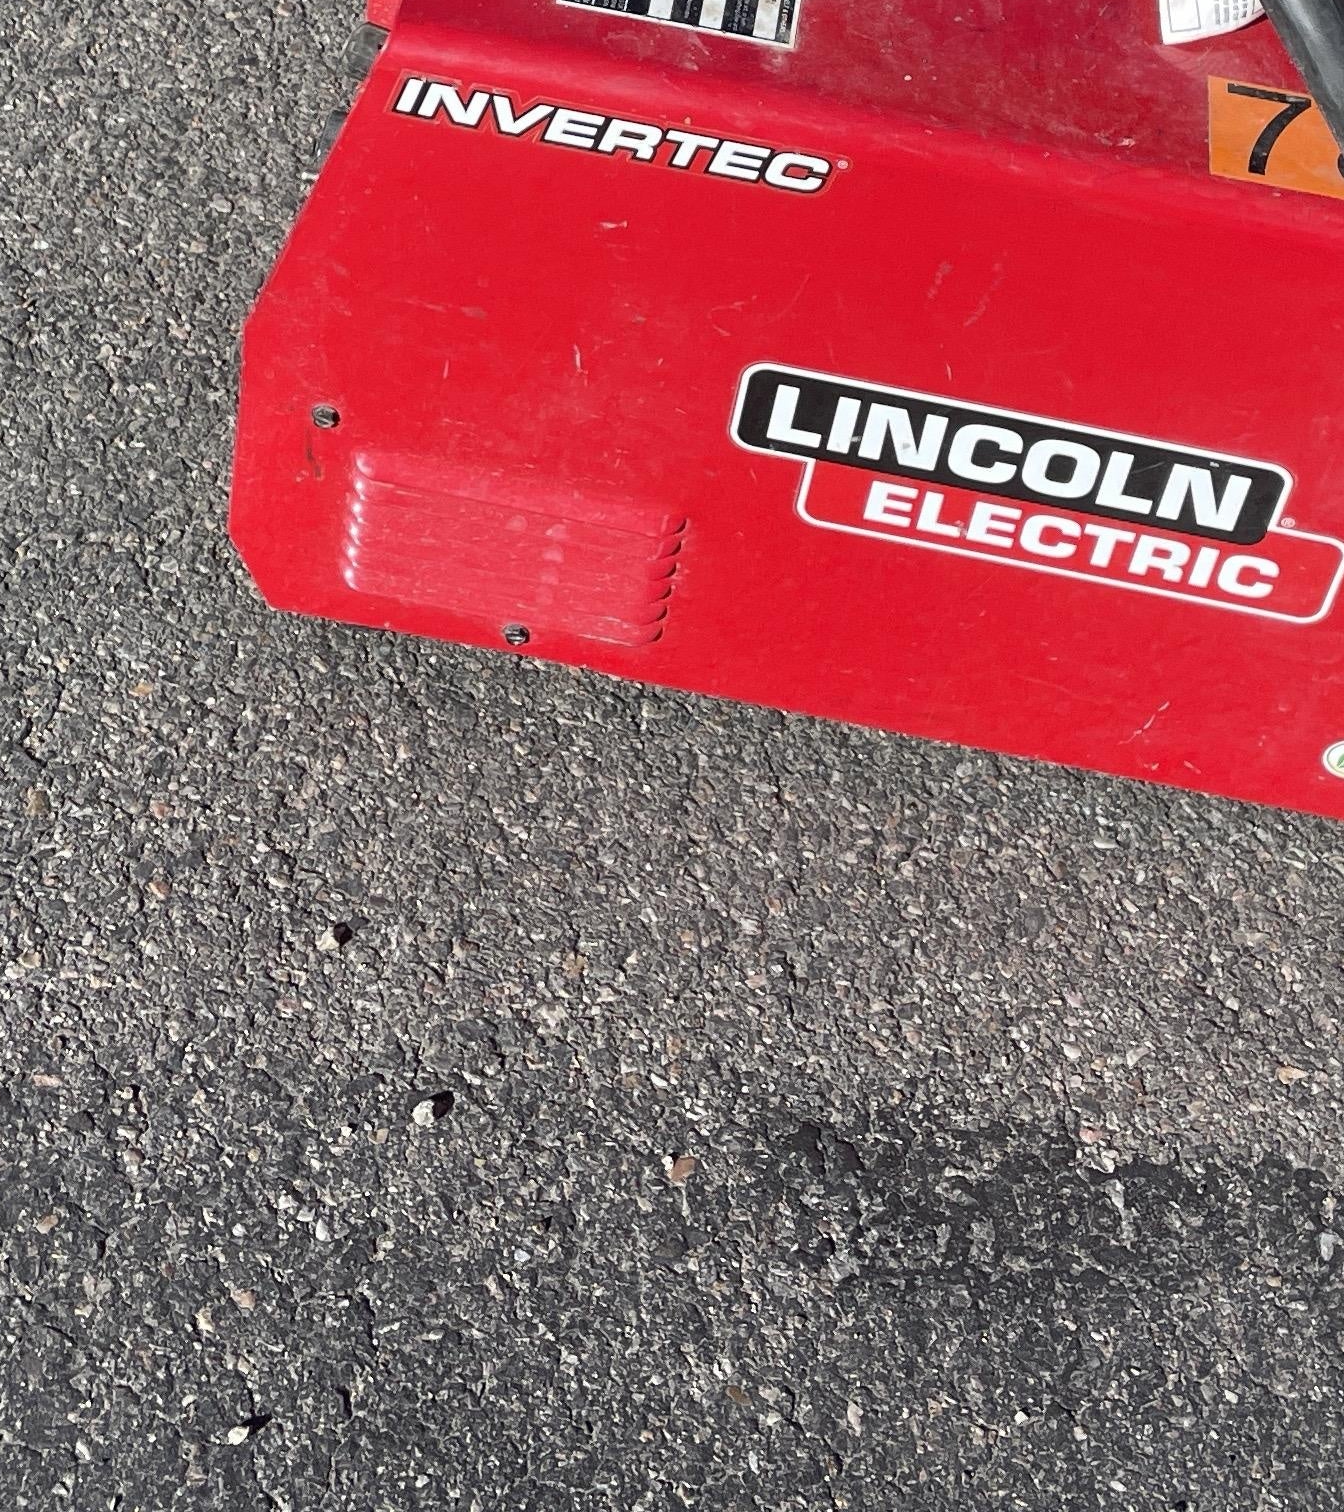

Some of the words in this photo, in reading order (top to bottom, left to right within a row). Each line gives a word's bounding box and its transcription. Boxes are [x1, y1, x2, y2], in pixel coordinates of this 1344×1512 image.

[393, 76, 832, 194] INVERTEC
[765, 383, 1253, 533] LINCOLN
[862, 480, 1280, 598] ELECTRIC
